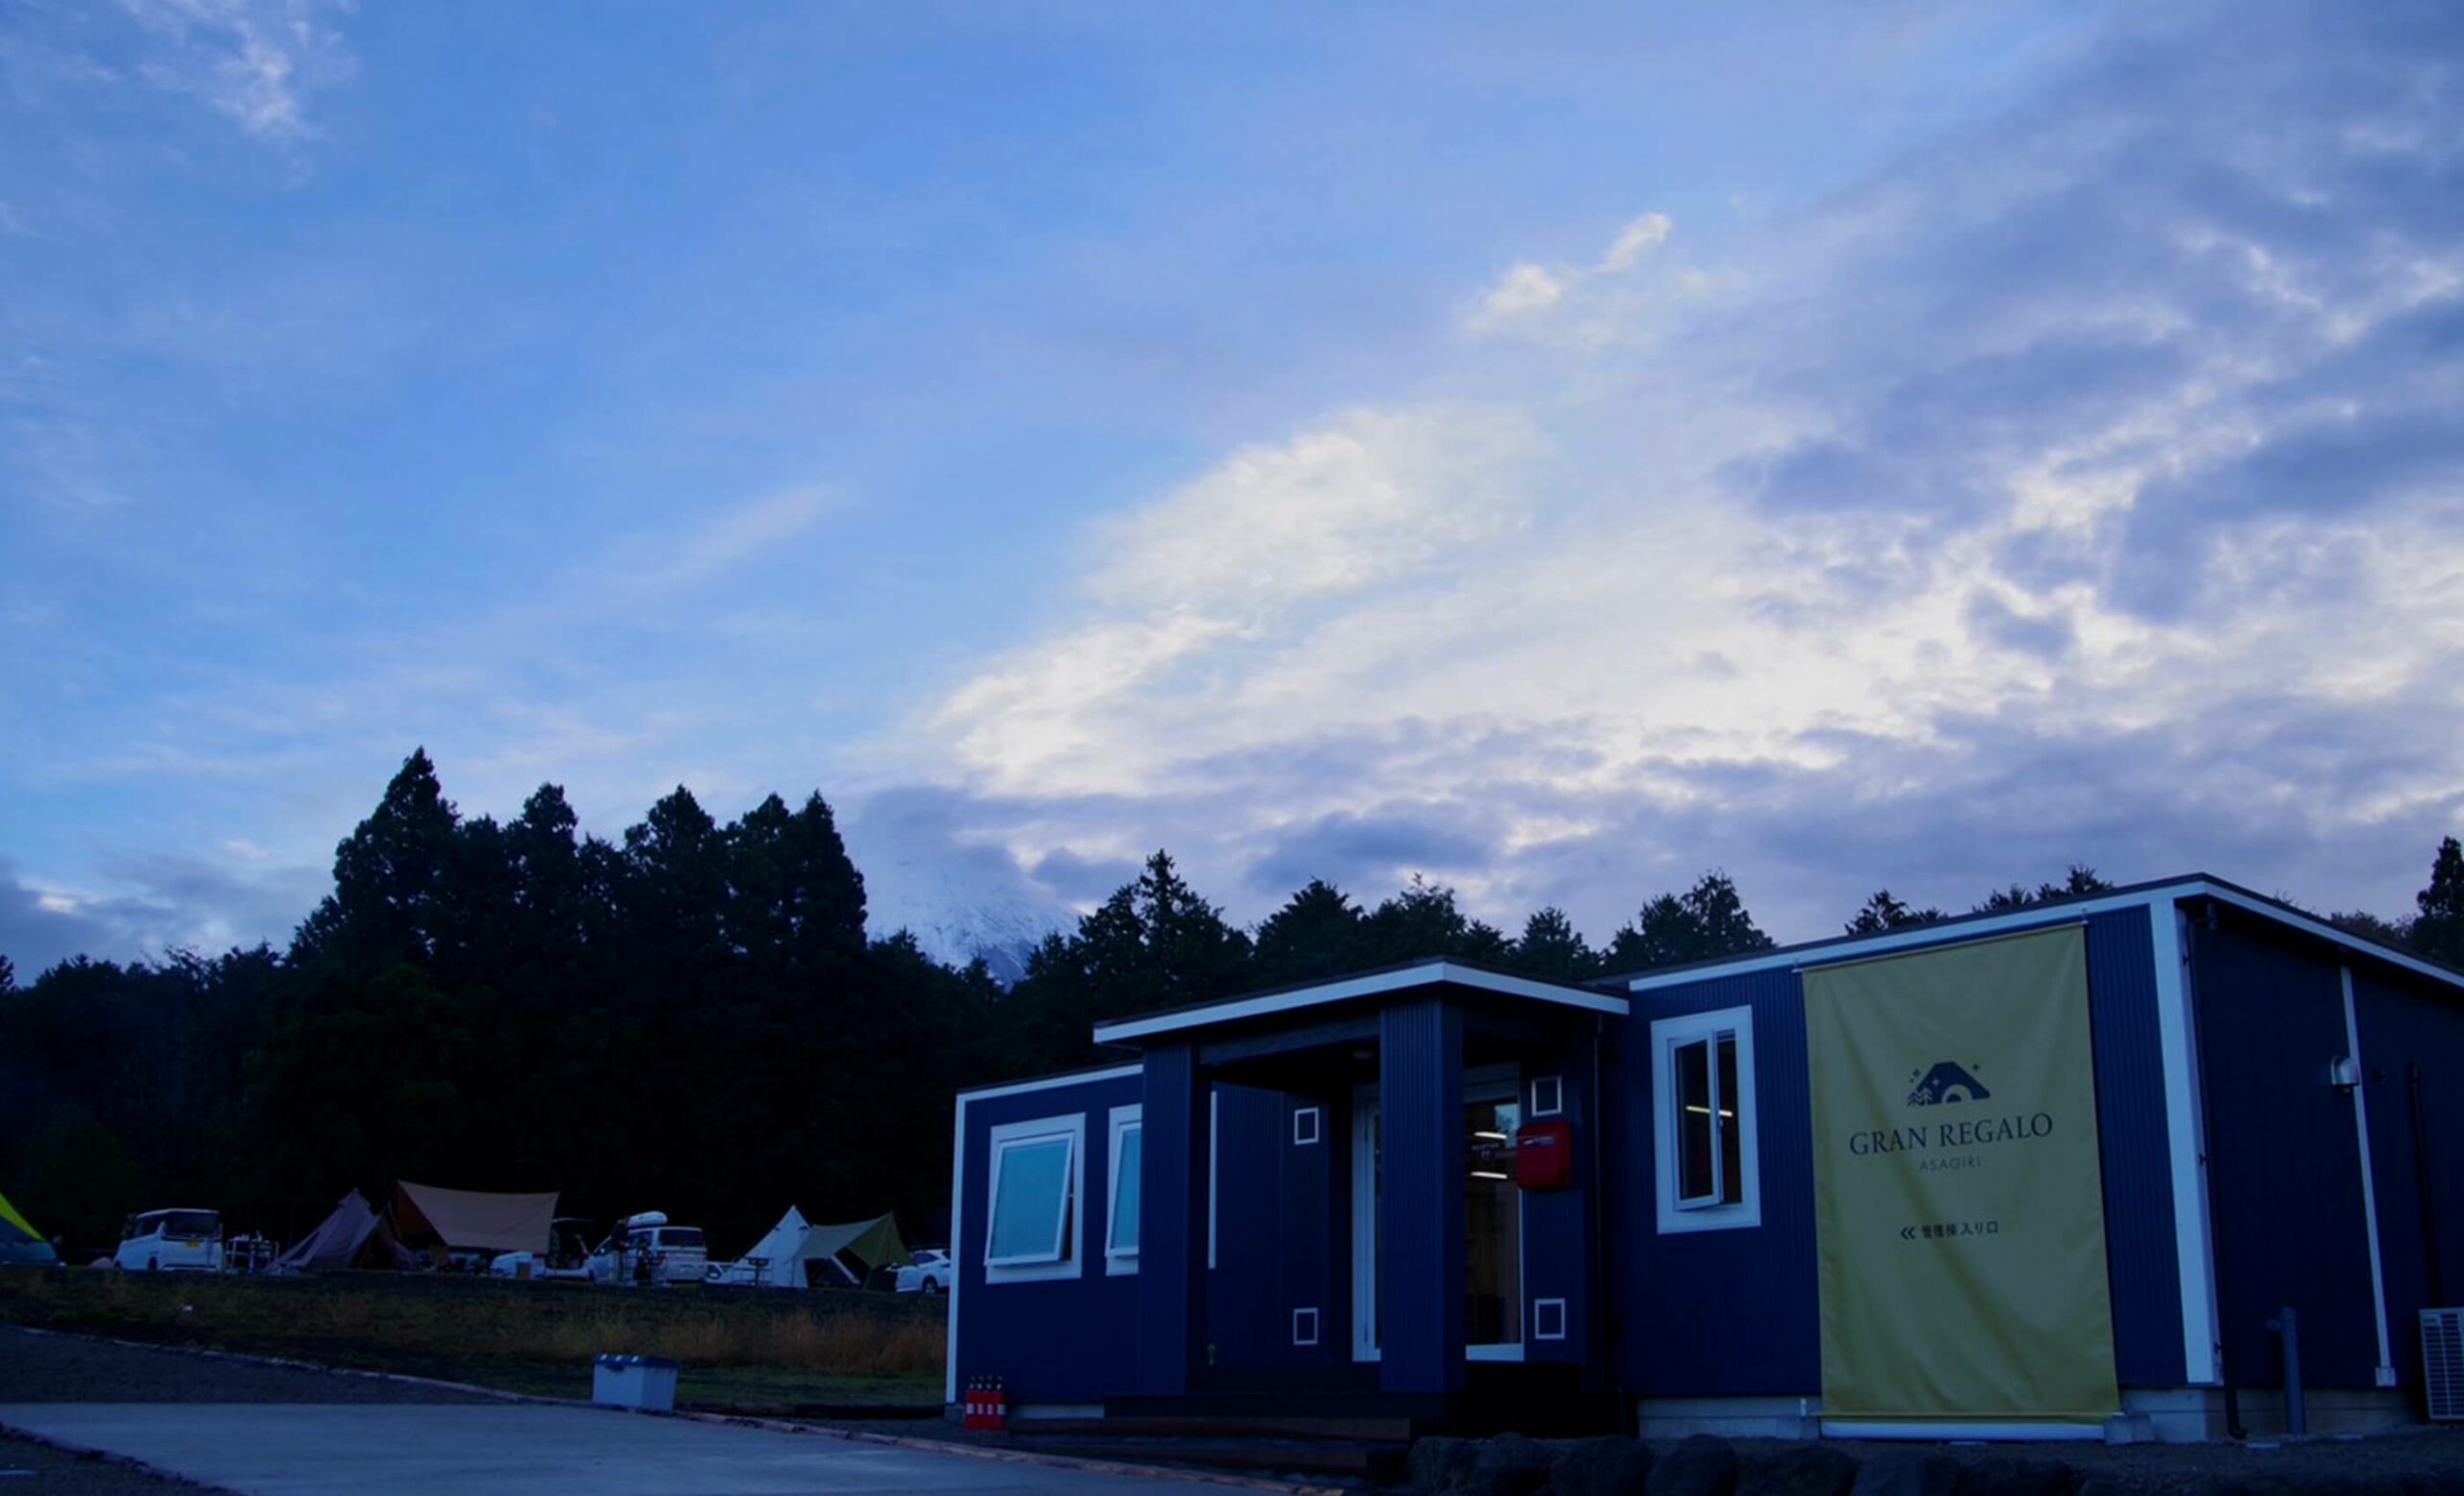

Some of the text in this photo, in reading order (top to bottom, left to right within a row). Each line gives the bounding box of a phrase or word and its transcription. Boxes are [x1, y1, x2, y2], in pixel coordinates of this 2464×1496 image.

[1849, 1113, 2053, 1155] GRAN REGALO
[1919, 1155, 1981, 1172] ASAGIRI
